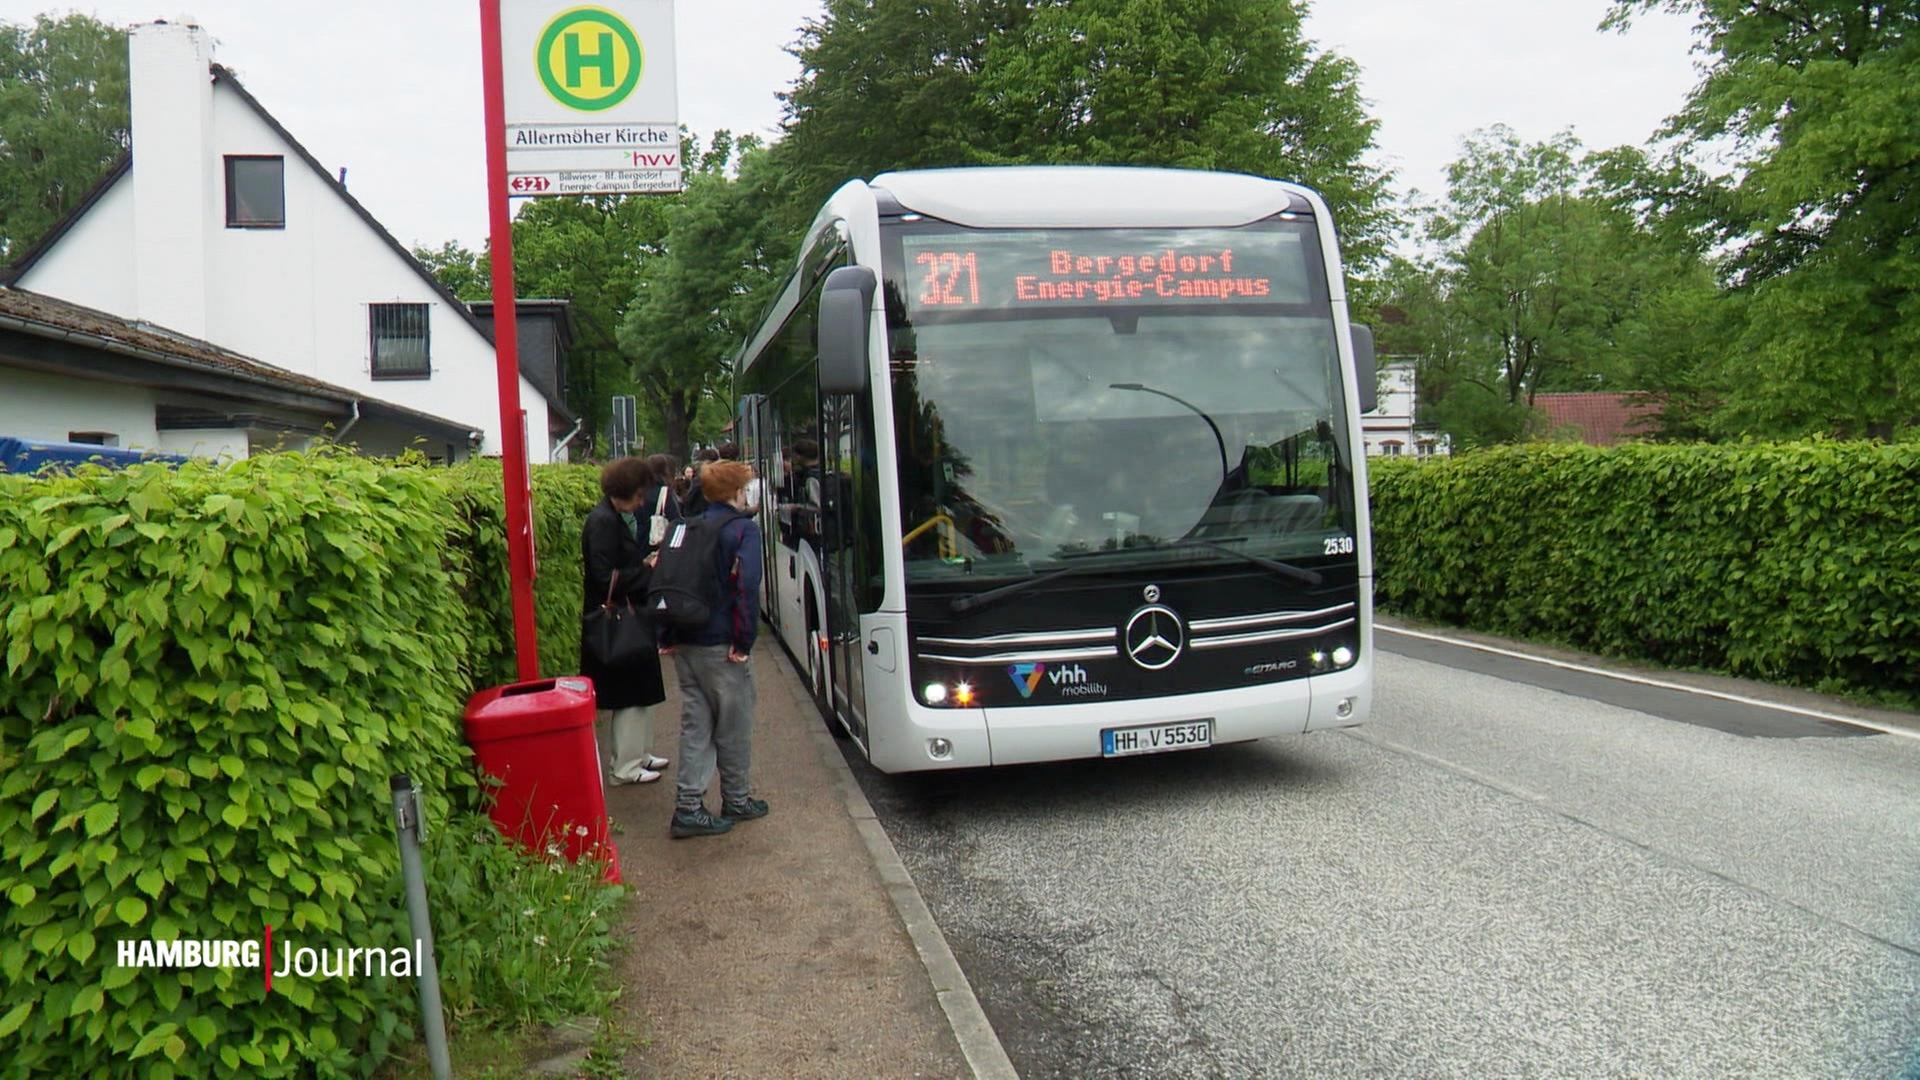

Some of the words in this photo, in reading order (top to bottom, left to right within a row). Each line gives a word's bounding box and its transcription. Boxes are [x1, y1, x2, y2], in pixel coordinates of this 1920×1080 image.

[564, 32, 615, 88] H
[516, 129, 611, 145] Allermöher
[616, 128, 668, 143] Kirche
[633, 151, 676, 167] hvv
[517, 176, 546, 191] 321
[618, 170, 662, 181] Bergedorf
[559, 181, 630, 192] Energie-Campus
[633, 180, 677, 191] Bergedorf
[1050, 249, 1232, 275] Bergedorf
[917, 252, 979, 304] 321
[1016, 274, 1270, 301] Energie-Campus
[1324, 536, 1353, 555] 2530
[1048, 664, 1087, 685] vhh
[1062, 683, 1107, 697] mobility
[1115, 732, 1138, 751] HH
[1150, 729, 1161, 747] V
[1165, 725, 1207, 745] 5530
